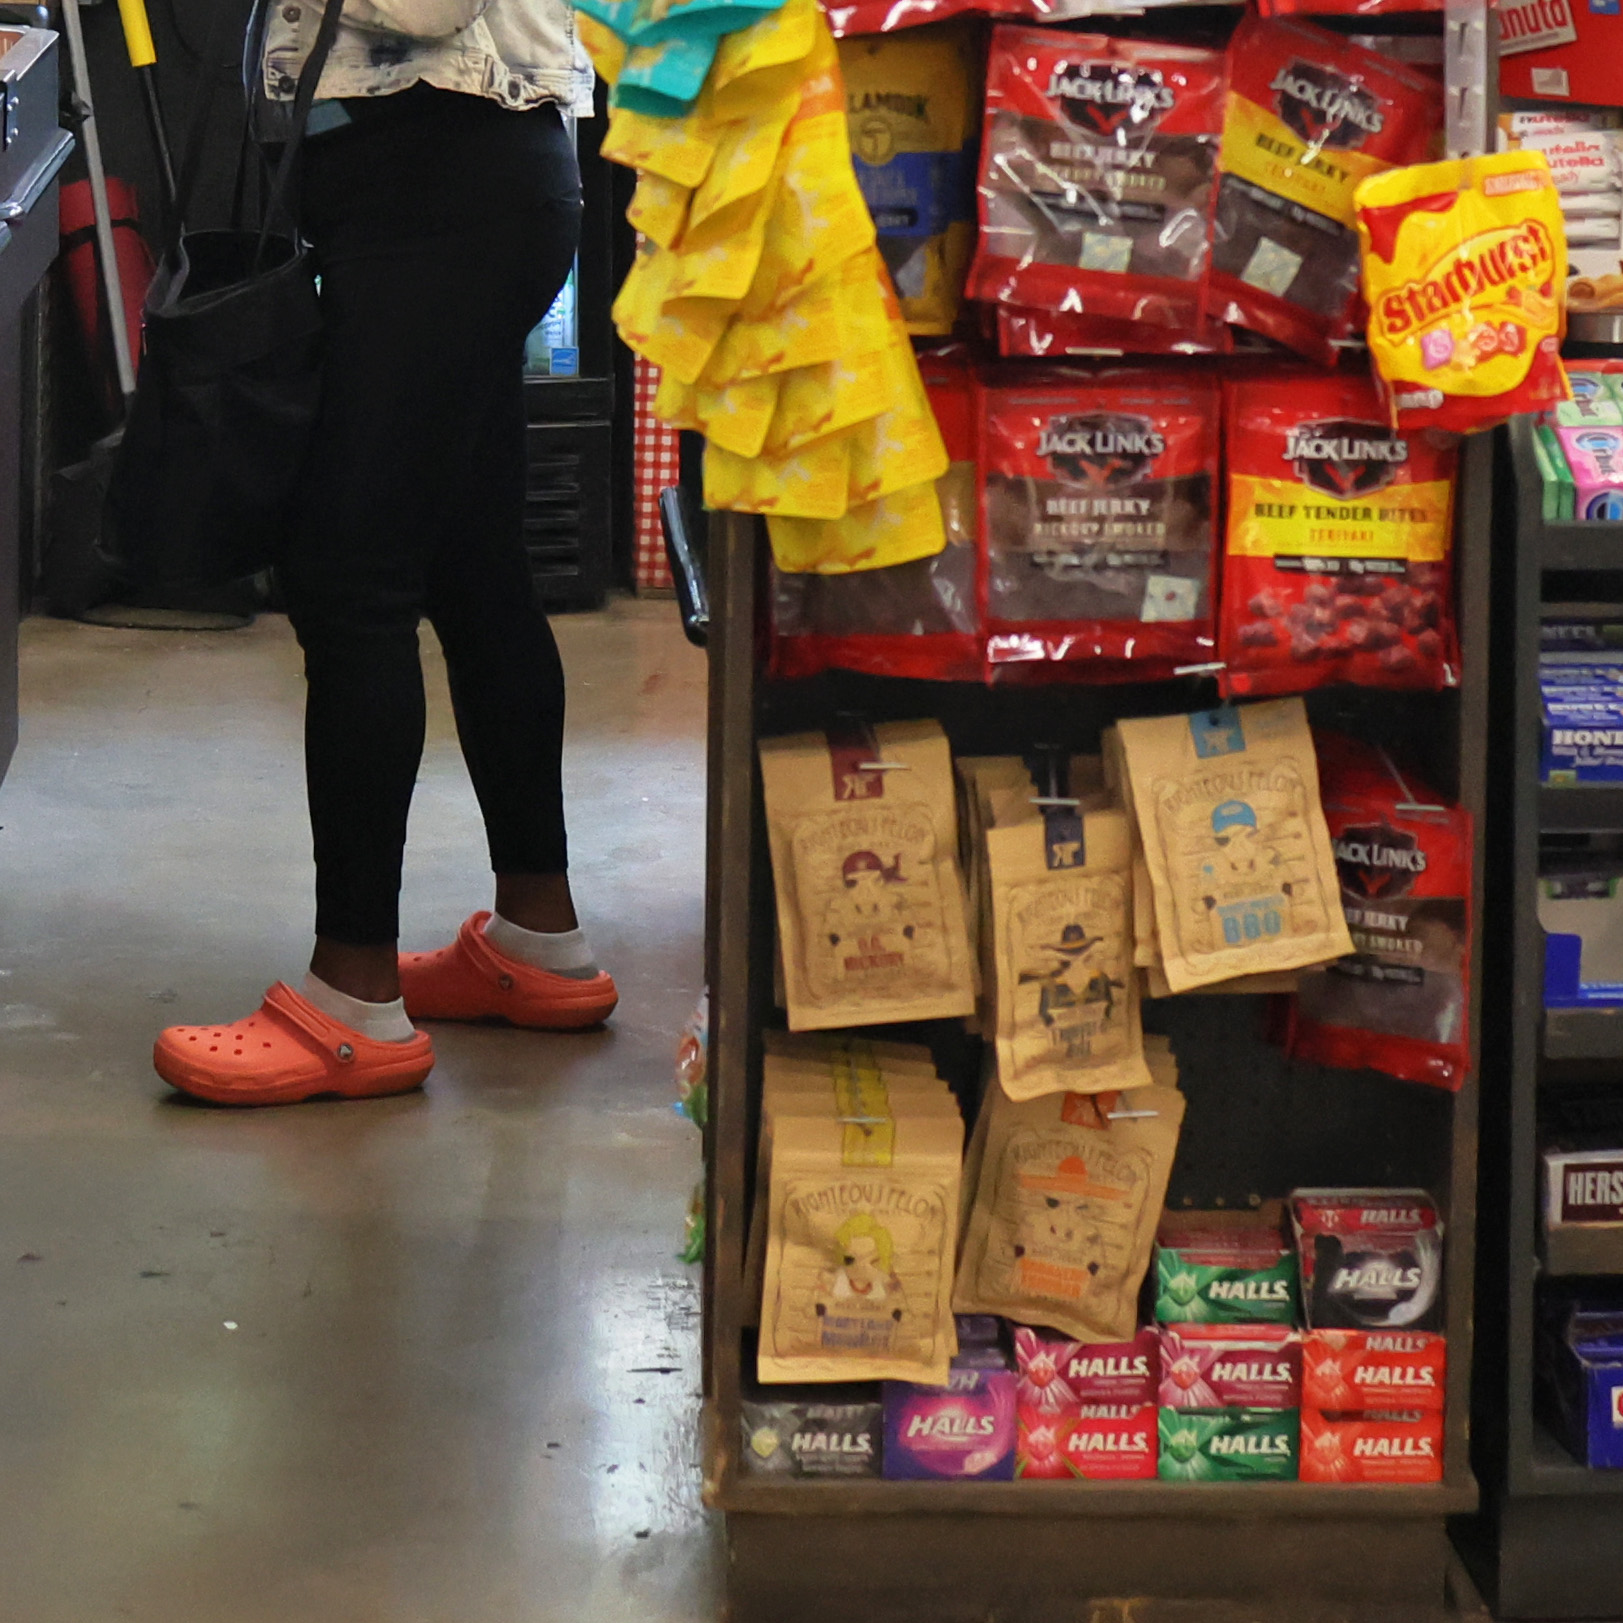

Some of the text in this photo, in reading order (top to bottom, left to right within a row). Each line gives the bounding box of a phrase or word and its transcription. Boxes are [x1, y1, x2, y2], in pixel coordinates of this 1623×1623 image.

[1270, 68, 1324, 110] JACK
[1379, 223, 1550, 334] Starburst
[1036, 428, 1165, 458] JACK LINK'S
[1283, 434, 1408, 464] JACK LINK'S
[1046, 497, 1089, 517] BEEF
[1253, 503, 1297, 520] BEEF
[1302, 504, 1375, 523] TENDER
[1333, 840, 1427, 873] ACK LINK'S
[1359, 1207, 1423, 1226] HALLS
[1209, 1278, 1288, 1302] HALLS
[1334, 1266, 1422, 1292] HALLS
[1069, 1356, 1149, 1380] HALLS
[1212, 1361, 1293, 1385] HALLS
[1353, 1363, 1436, 1387] HALLS
[906, 1414, 995, 1438] HALLS
[791, 1430, 871, 1455] HALLS
[1068, 1429, 1148, 1455] HALLS
[1210, 1434, 1290, 1458] HALLS
[1354, 1433, 1435, 1457] HALLS
